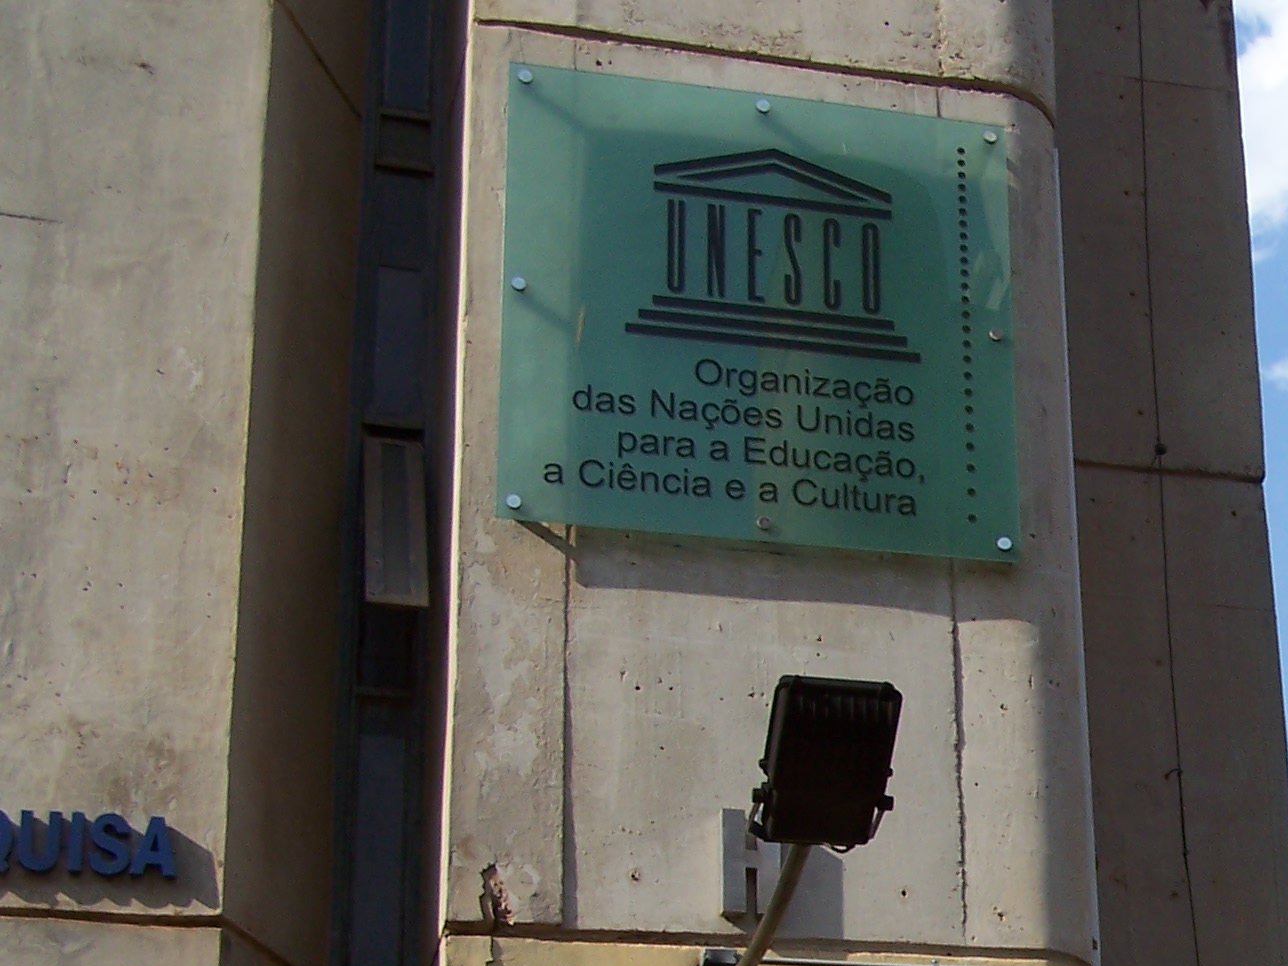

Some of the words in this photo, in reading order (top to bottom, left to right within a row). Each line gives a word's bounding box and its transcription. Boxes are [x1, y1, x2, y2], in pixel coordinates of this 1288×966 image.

[667, 199, 879, 314] UNESCO
[695, 358, 914, 408] Organização
[572, 384, 636, 415] das
[651, 388, 783, 430] Nações
[797, 404, 915, 442] Unidas
[617, 431, 695, 459] para
[709, 439, 729, 461] a
[744, 436, 925, 484] Educação,
[543, 462, 563, 485] a
[579, 459, 711, 498] Ciência
[725, 479, 746, 500] e
[759, 481, 778, 503] a
[792, 478, 917, 516] Cultura
